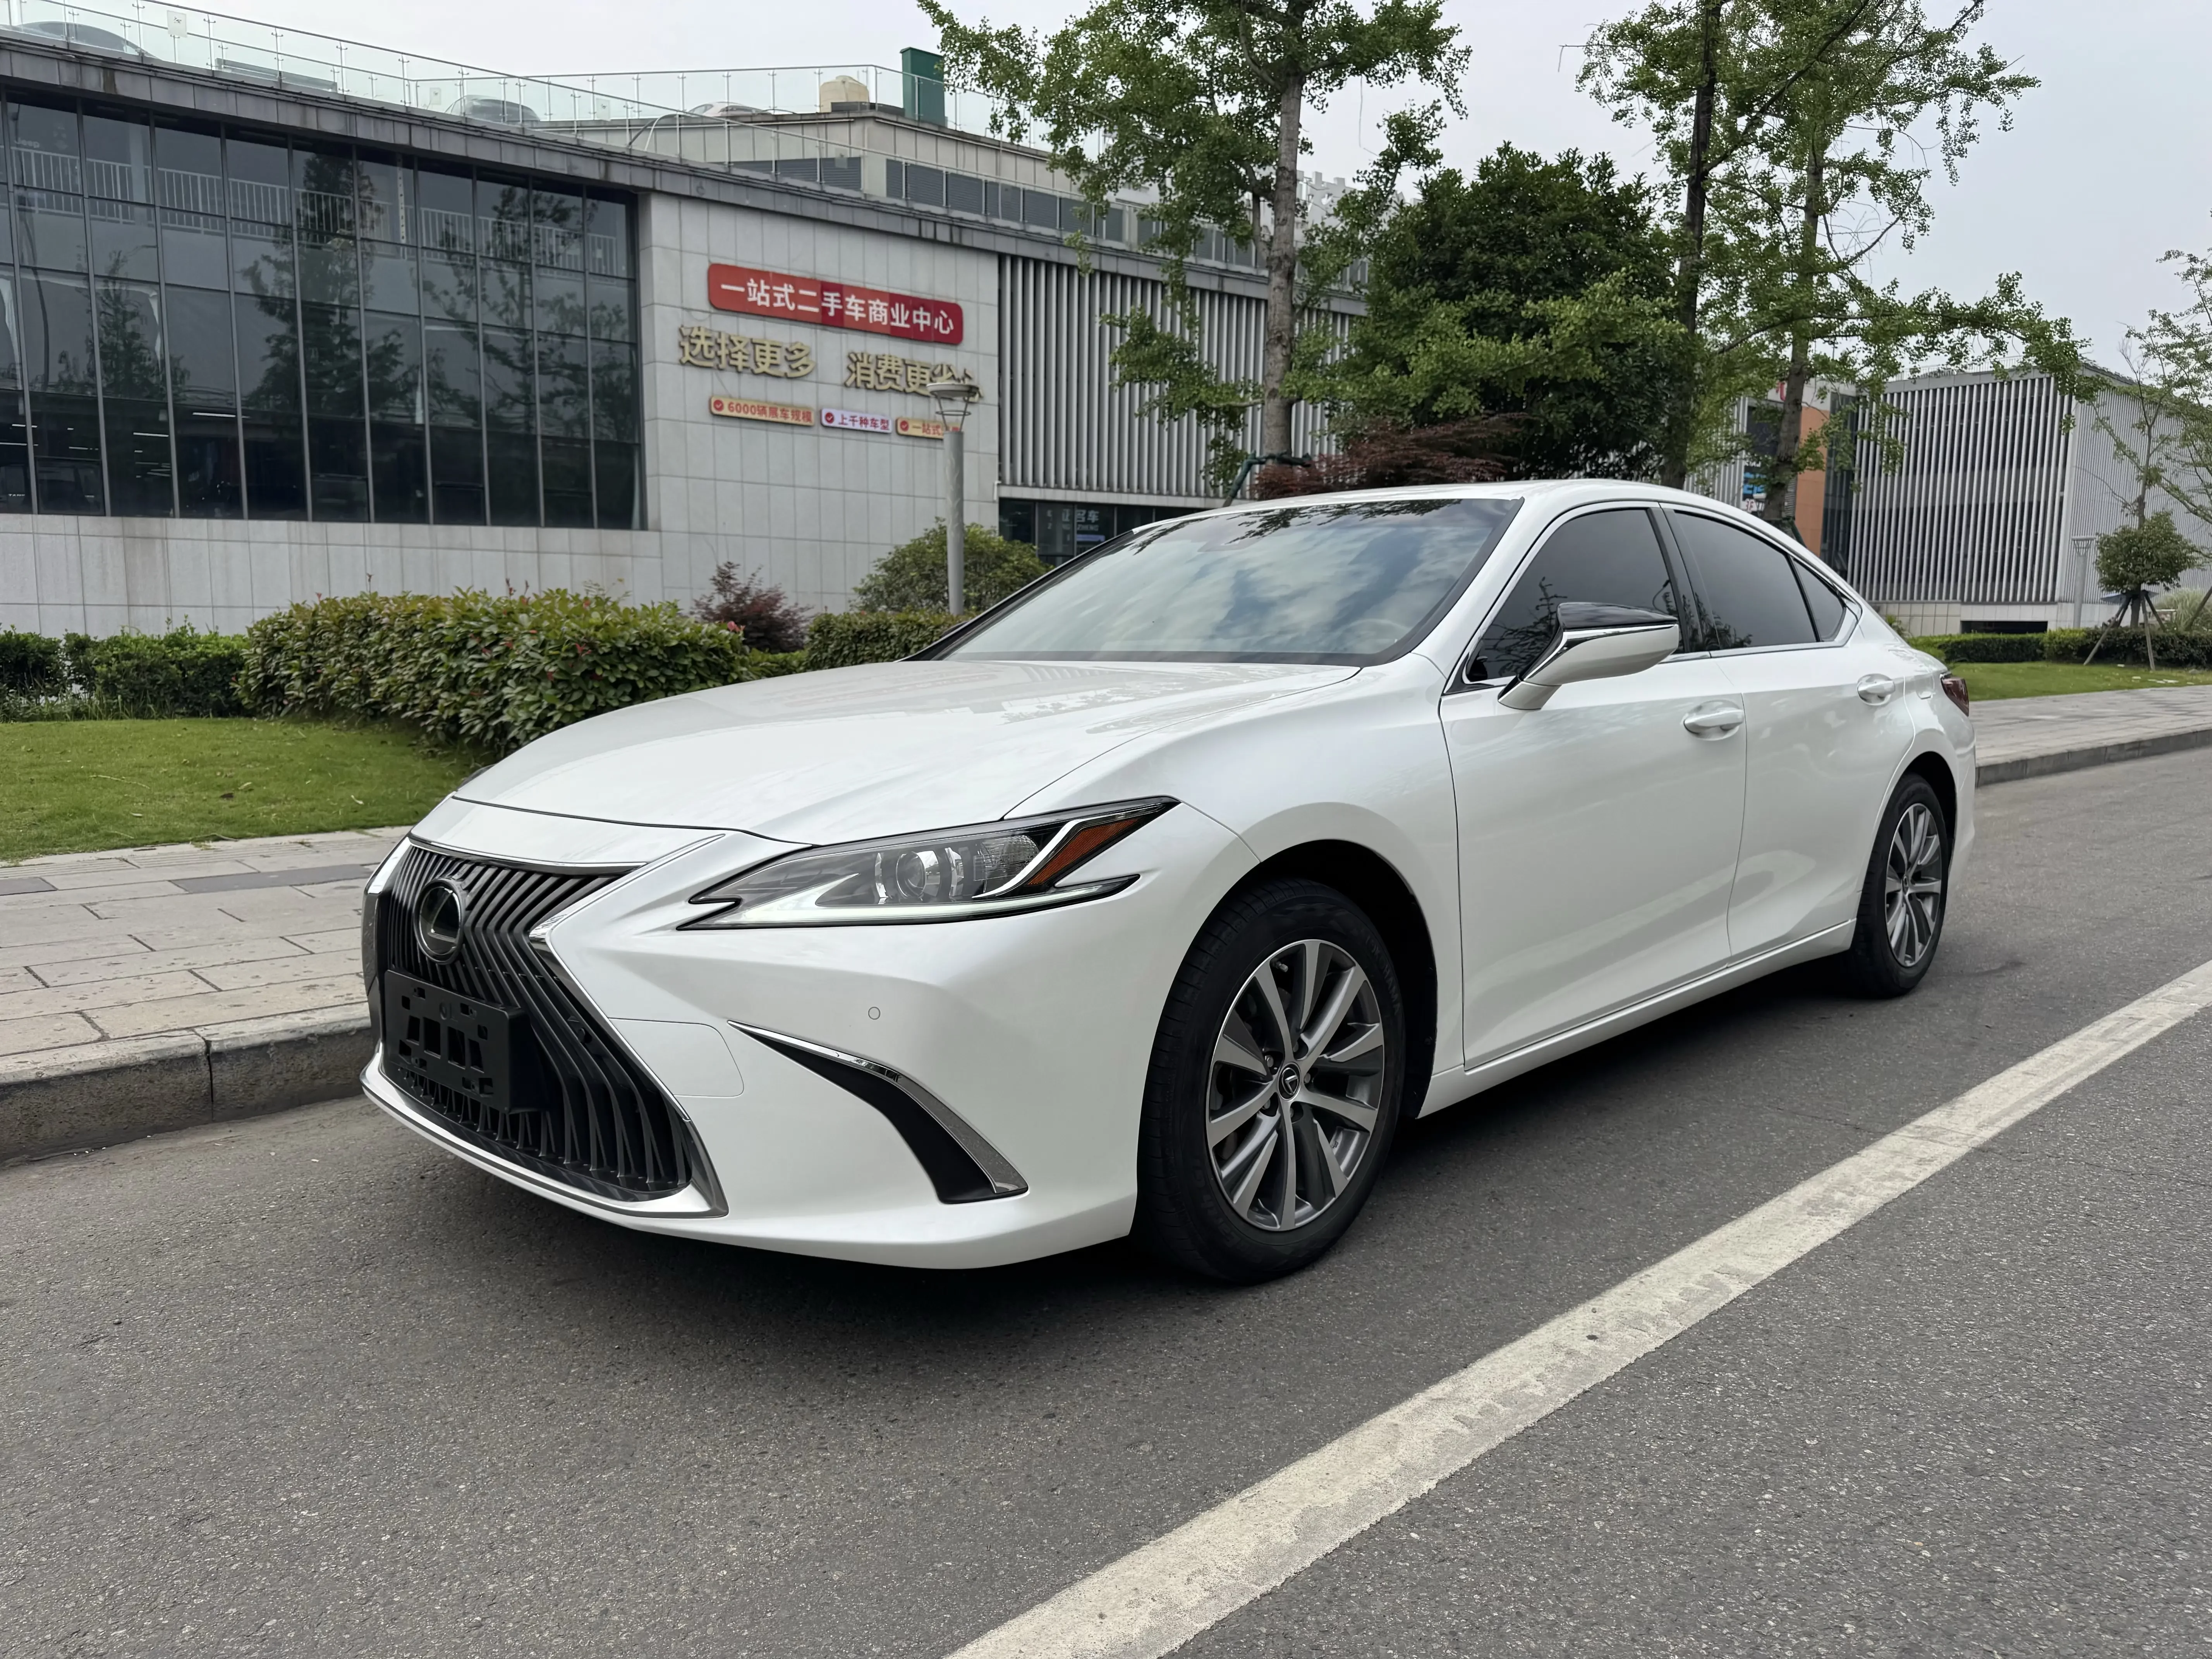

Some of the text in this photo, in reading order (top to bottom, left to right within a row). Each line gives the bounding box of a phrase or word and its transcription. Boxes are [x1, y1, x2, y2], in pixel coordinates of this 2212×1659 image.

[721, 278, 954, 335] 一站式二手车商业中心
[678, 326, 816, 378] 选择更多
[728, 402, 812, 423] 6000辆展车规模
[838, 414, 890, 431] 上千种车型
